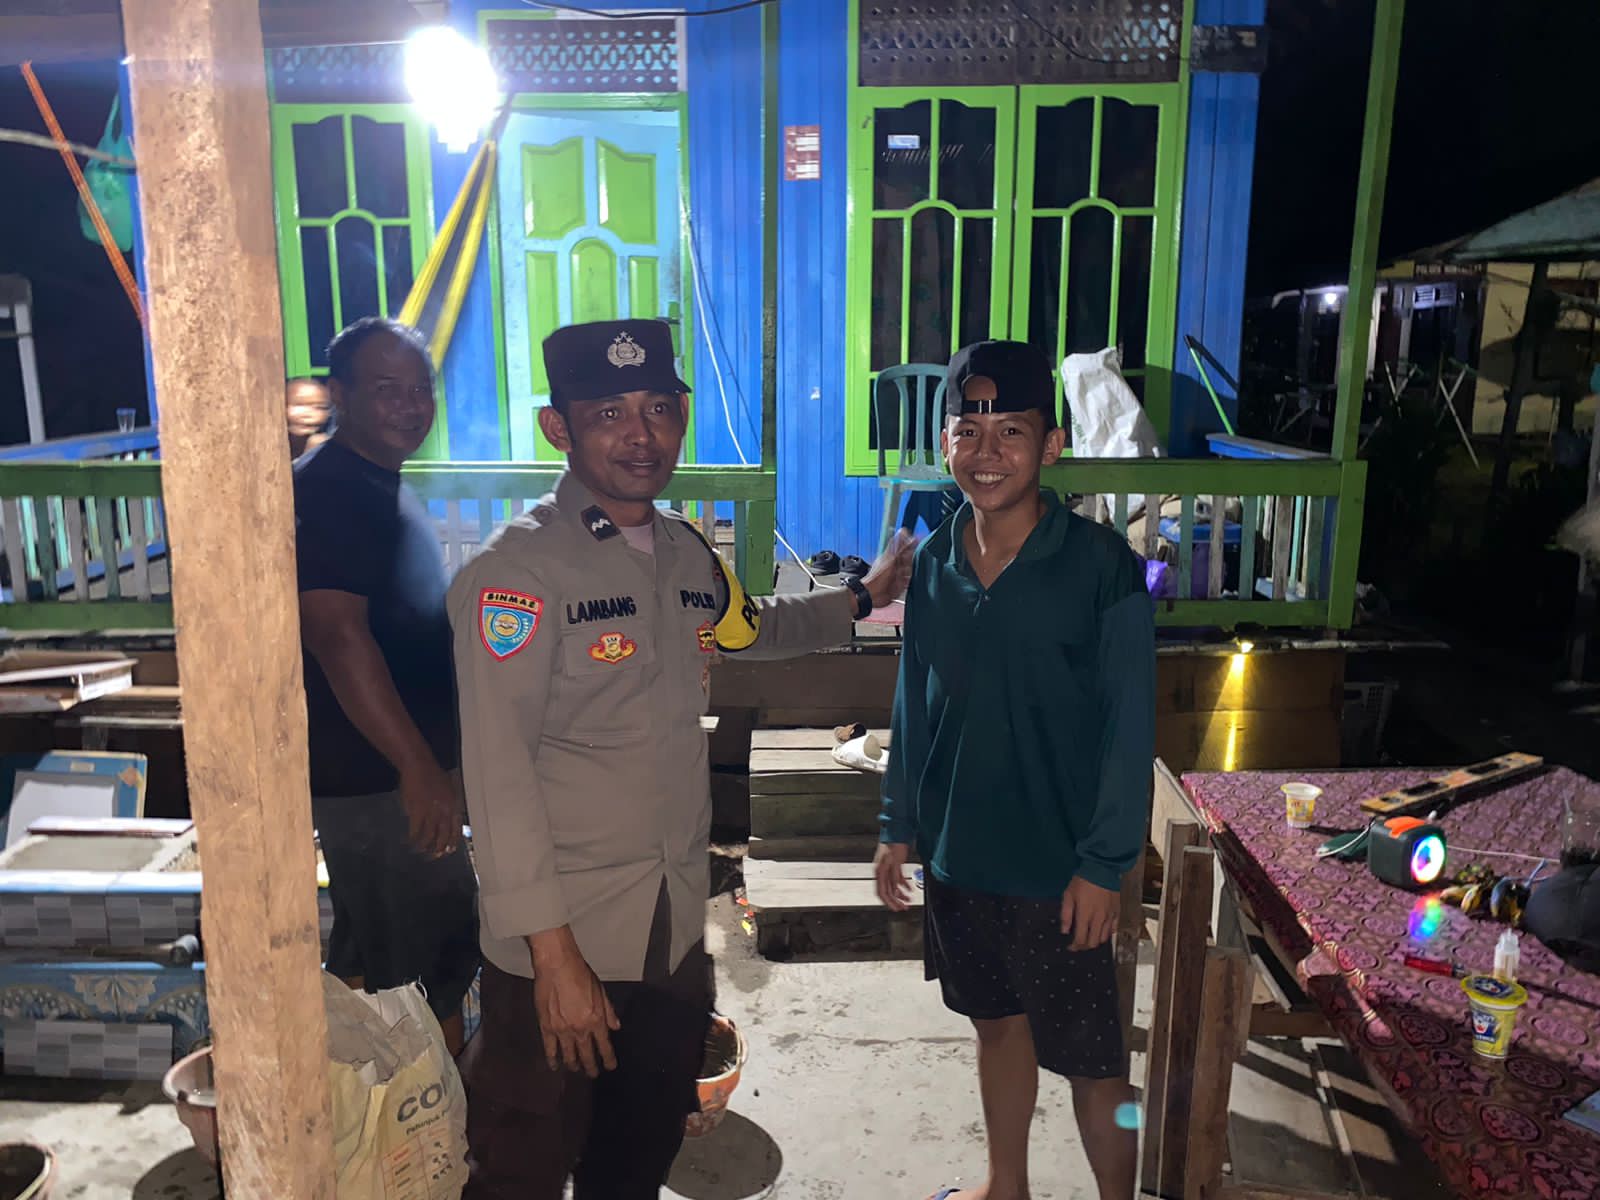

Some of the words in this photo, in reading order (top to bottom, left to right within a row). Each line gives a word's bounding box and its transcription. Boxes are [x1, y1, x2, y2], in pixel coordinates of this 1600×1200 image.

[487, 593, 536, 608] BINMAS
[566, 596, 637, 624] LAMBANG
[397, 1077, 447, 1122] CO
